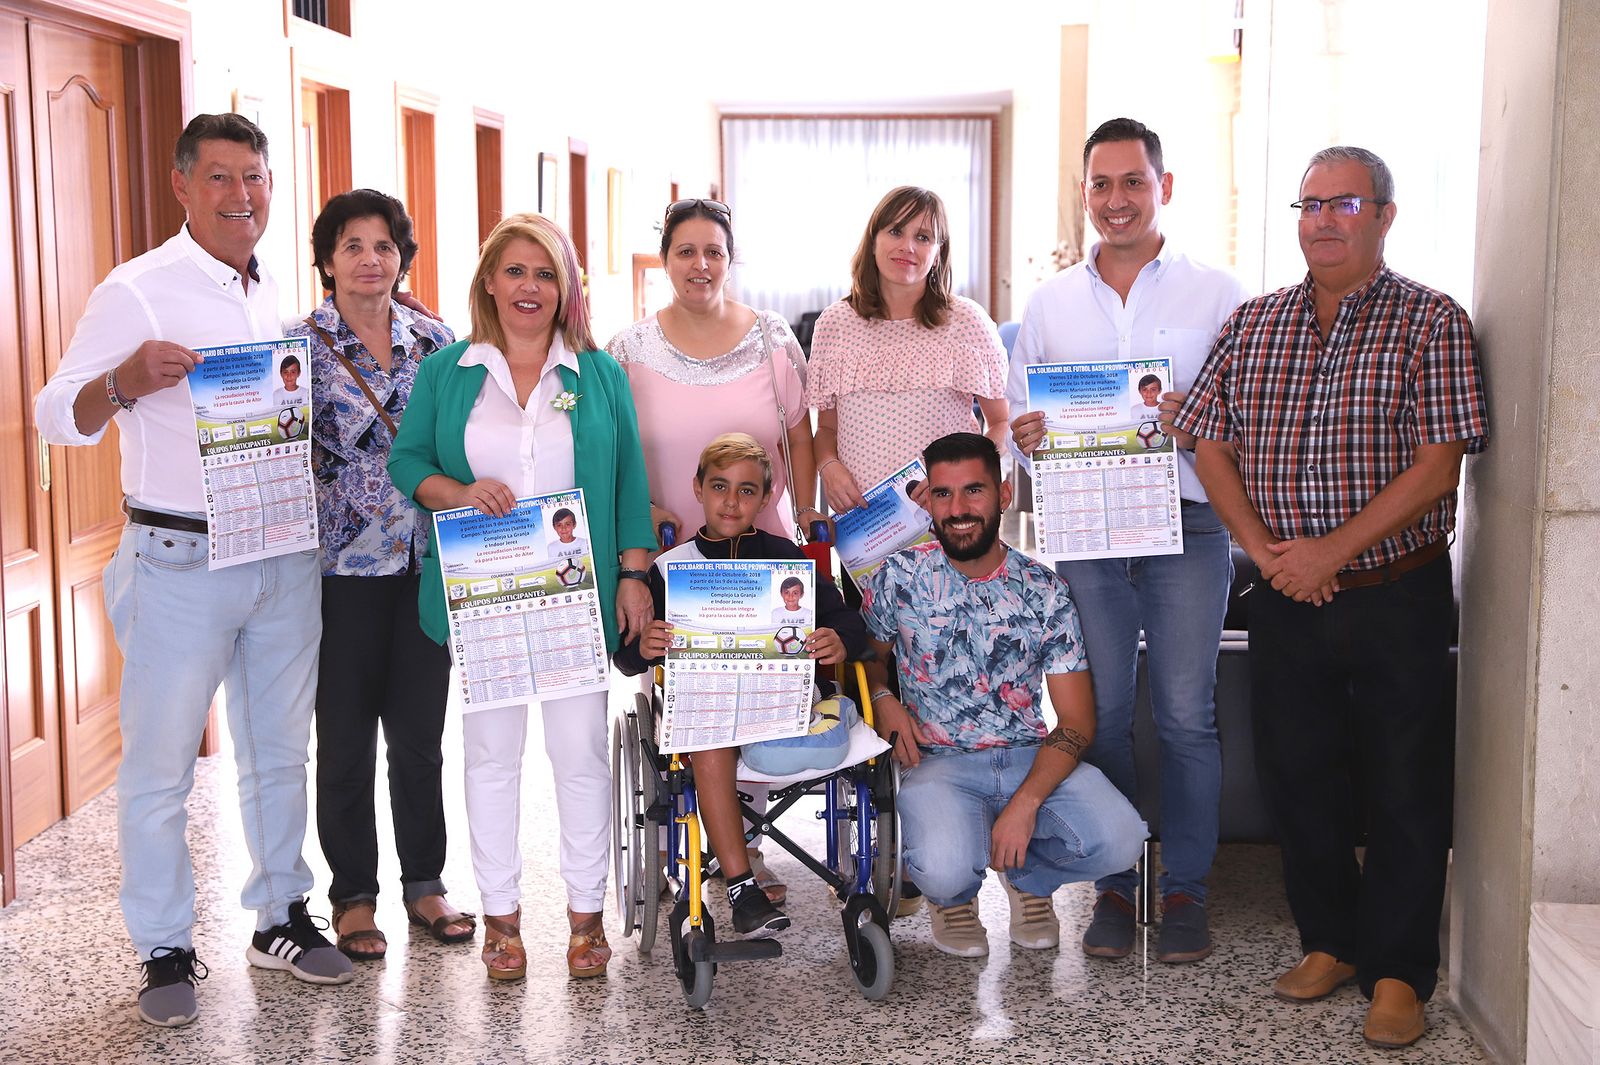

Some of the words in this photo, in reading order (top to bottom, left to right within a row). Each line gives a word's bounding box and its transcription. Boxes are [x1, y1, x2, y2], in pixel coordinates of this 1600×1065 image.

[1036, 366, 1063, 374] SOLIDARIO
[1106, 362, 1134, 371] PROVINCIAL
[1074, 449, 1126, 458] PARTICIPANTES
[436, 513, 446, 522] DIA
[446, 509, 474, 520] SOLIDARIO
[517, 498, 546, 510] PROVINCIAL
[547, 496, 558, 505] CON
[460, 597, 491, 608] EQUIPOS
[492, 589, 547, 604] PARTICIPANTES
